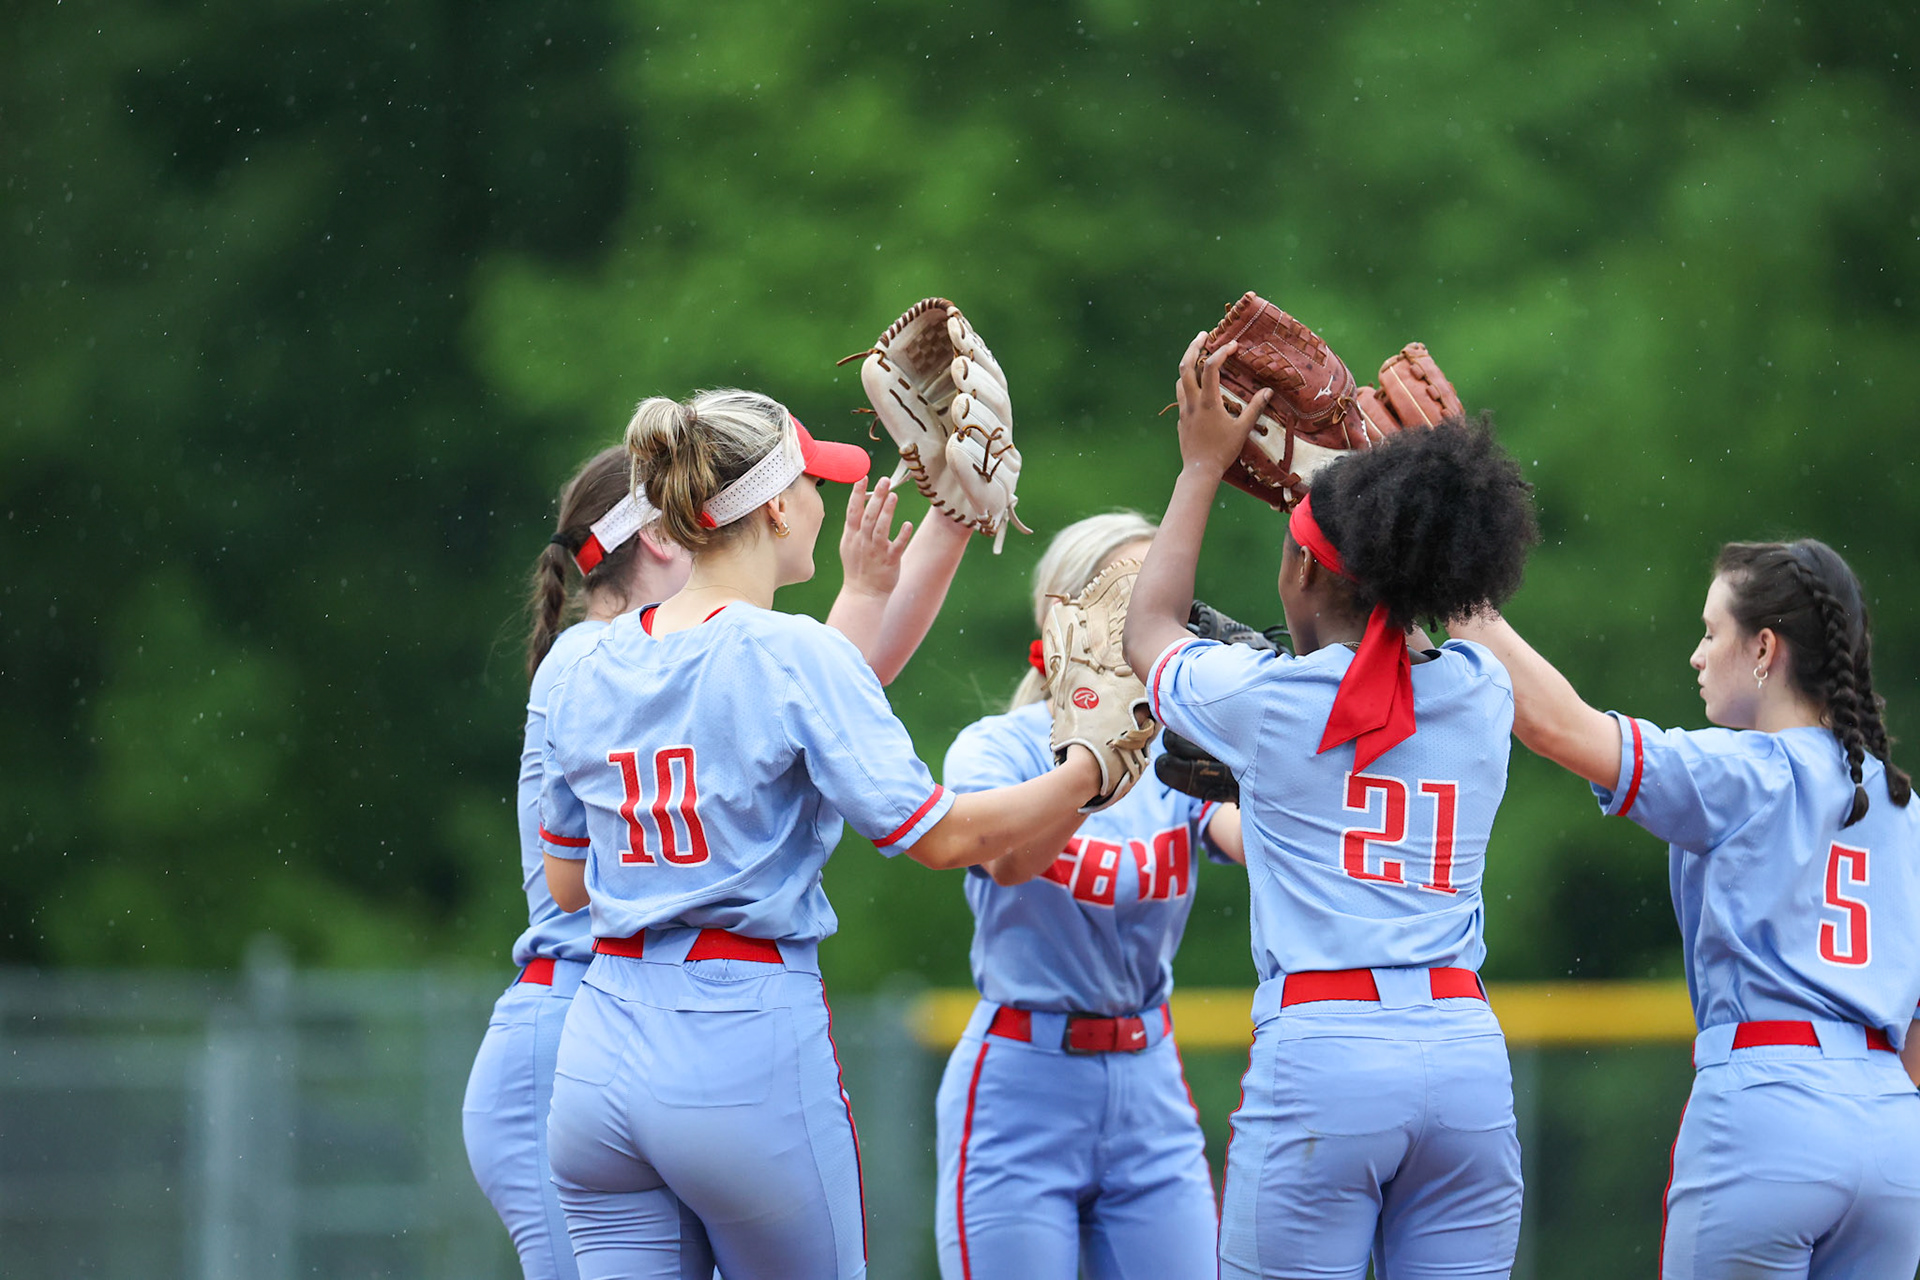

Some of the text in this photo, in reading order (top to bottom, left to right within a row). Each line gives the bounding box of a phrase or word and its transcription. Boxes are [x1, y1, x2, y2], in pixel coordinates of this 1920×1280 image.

[606, 744, 711, 868] 10
[1339, 771, 1459, 897] 21
[1816, 839, 1872, 970] 5
